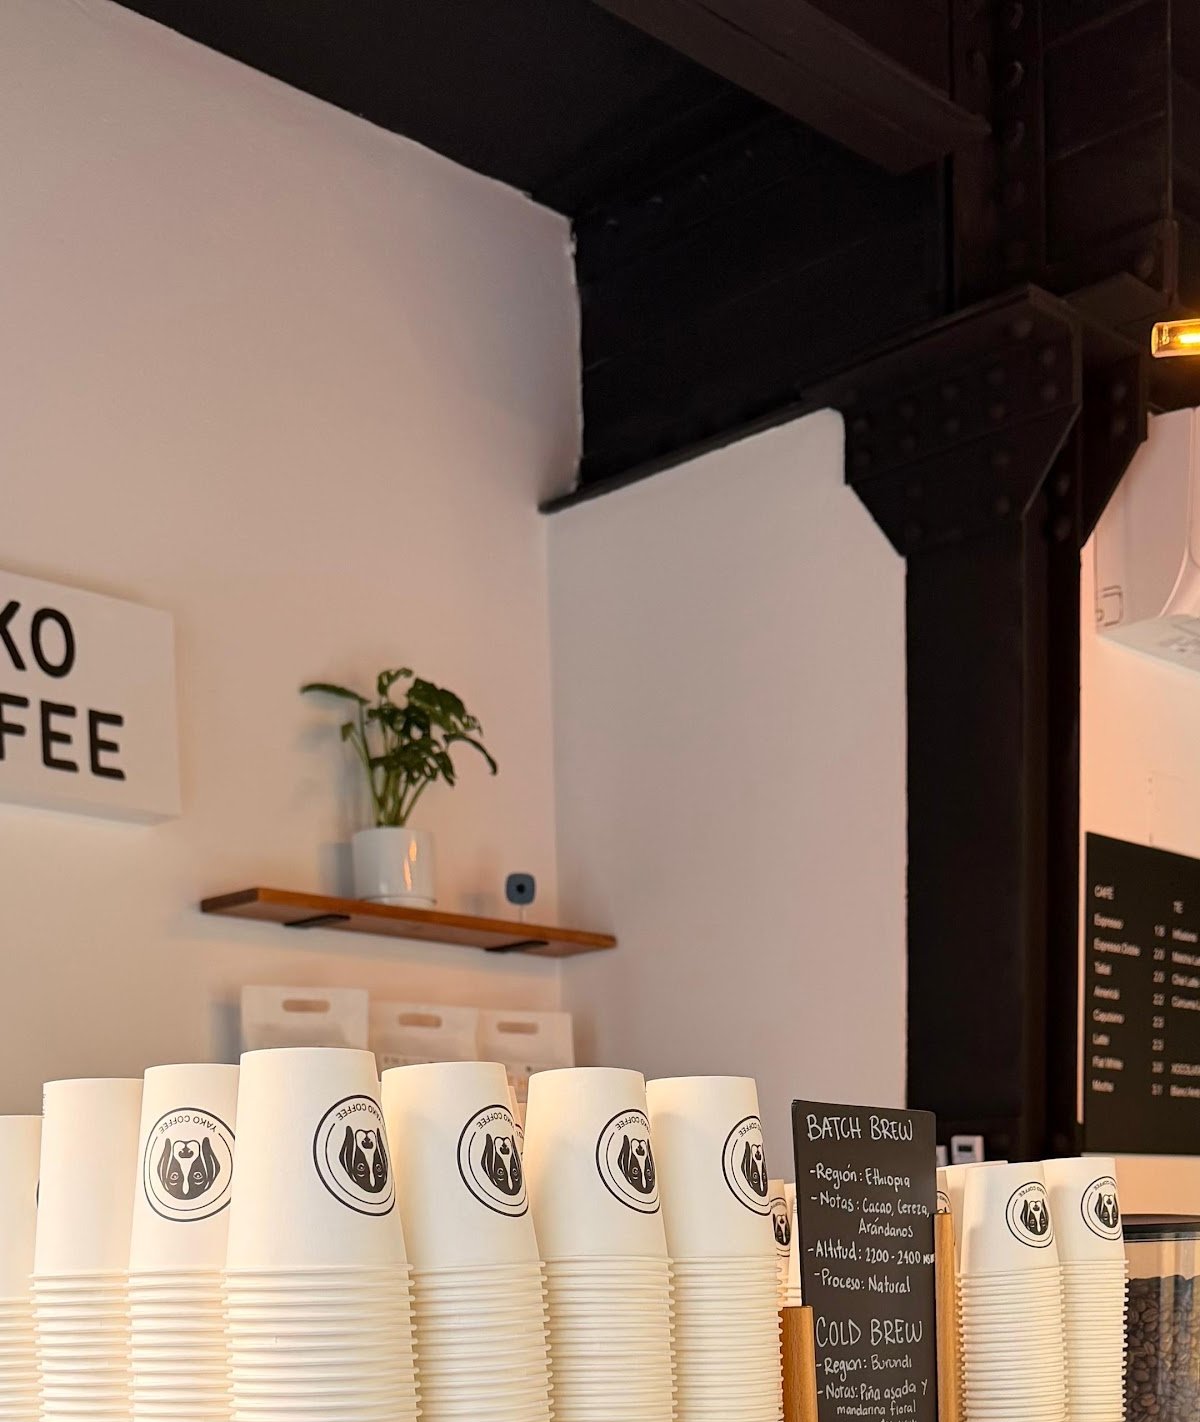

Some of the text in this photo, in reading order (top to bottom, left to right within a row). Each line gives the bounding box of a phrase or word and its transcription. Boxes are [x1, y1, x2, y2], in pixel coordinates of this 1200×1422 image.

[335, 1103, 367, 1121] COFFEE
[476, 1112, 503, 1129] COFFEE
[159, 1115, 217, 1134] YAKO COFFEE
[615, 1116, 640, 1131] COFFEE
[806, 1113, 913, 1141] BATCH BREW
[864, 1167, 911, 1192] Ethiopia
[858, 1217, 914, 1238] Arándanos
[867, 1275, 911, 1294] Natural
[815, 1316, 923, 1348] COLD BREW
[870, 1354, 912, 1371] Burundi
[884, 1379, 917, 1400] asada
[836, 1400, 917, 1417] mandarina floral
